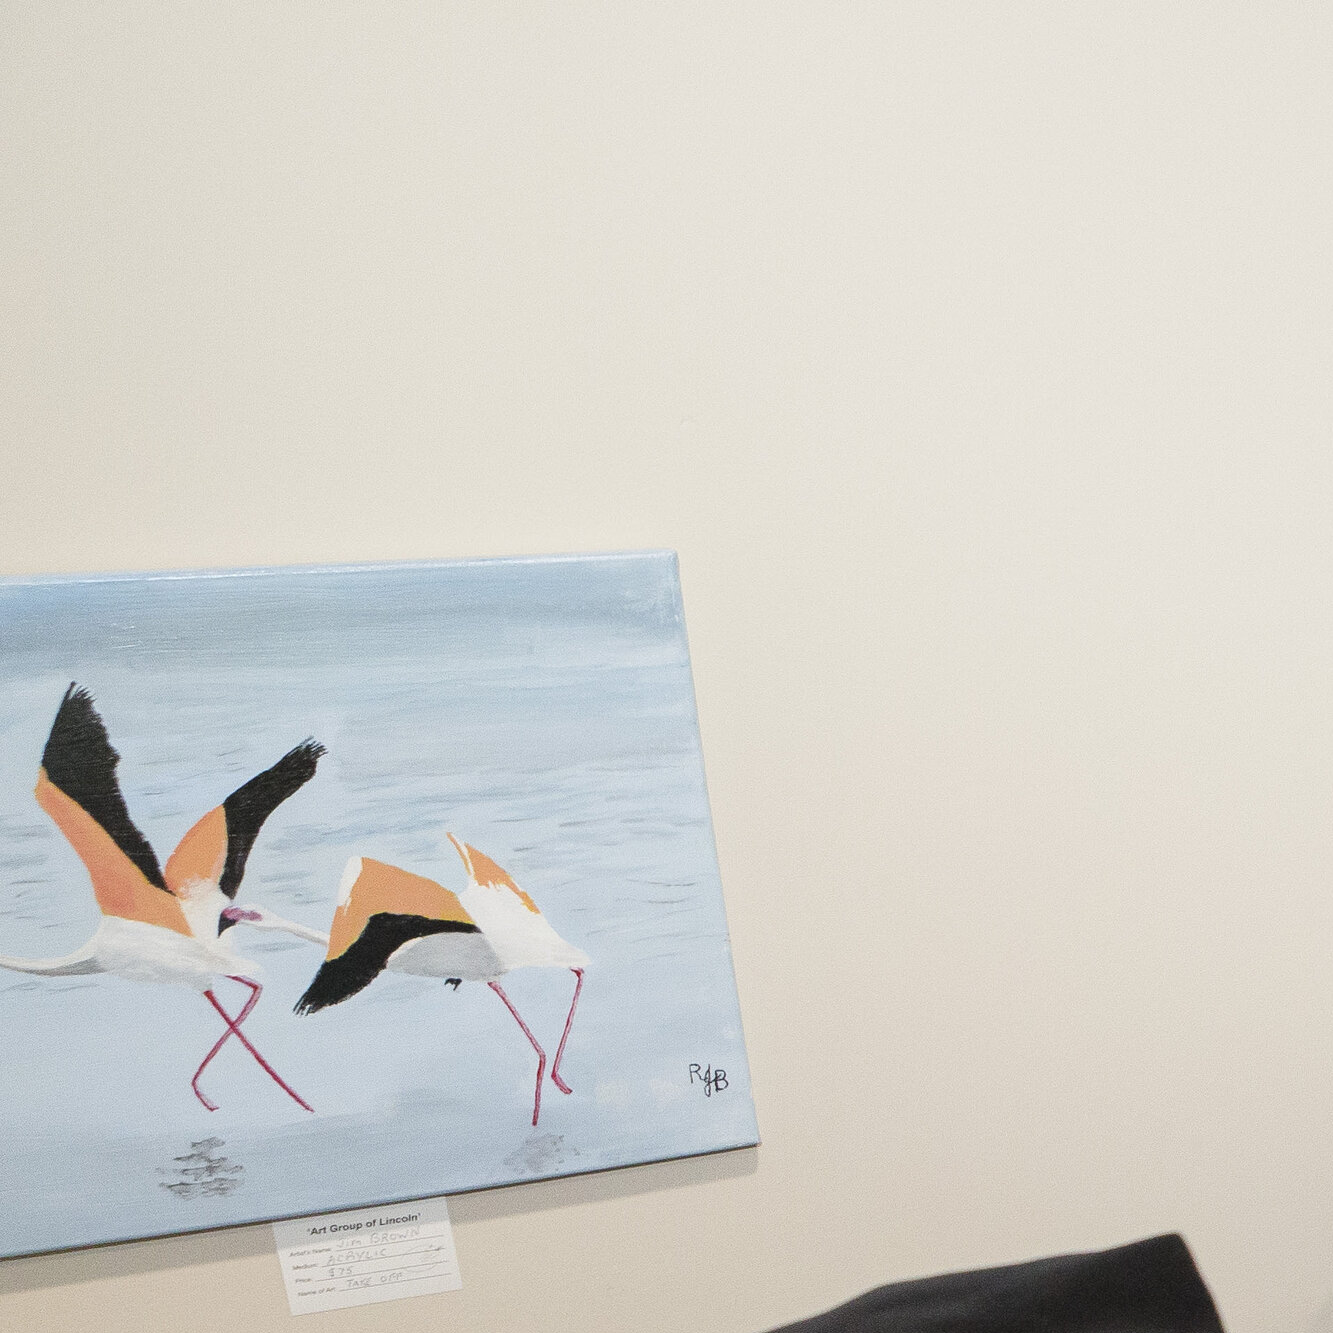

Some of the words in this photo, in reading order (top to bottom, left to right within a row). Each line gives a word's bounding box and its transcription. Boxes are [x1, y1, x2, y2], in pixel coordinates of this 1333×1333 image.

[329, 1222, 363, 1234] Group
[365, 1218, 377, 1228] of
[369, 1226, 421, 1244] BROWN
[327, 1248, 387, 1265] ACRYLIC
[346, 1276, 373, 1288] TAKE
[380, 1271, 405, 1283] OFF
